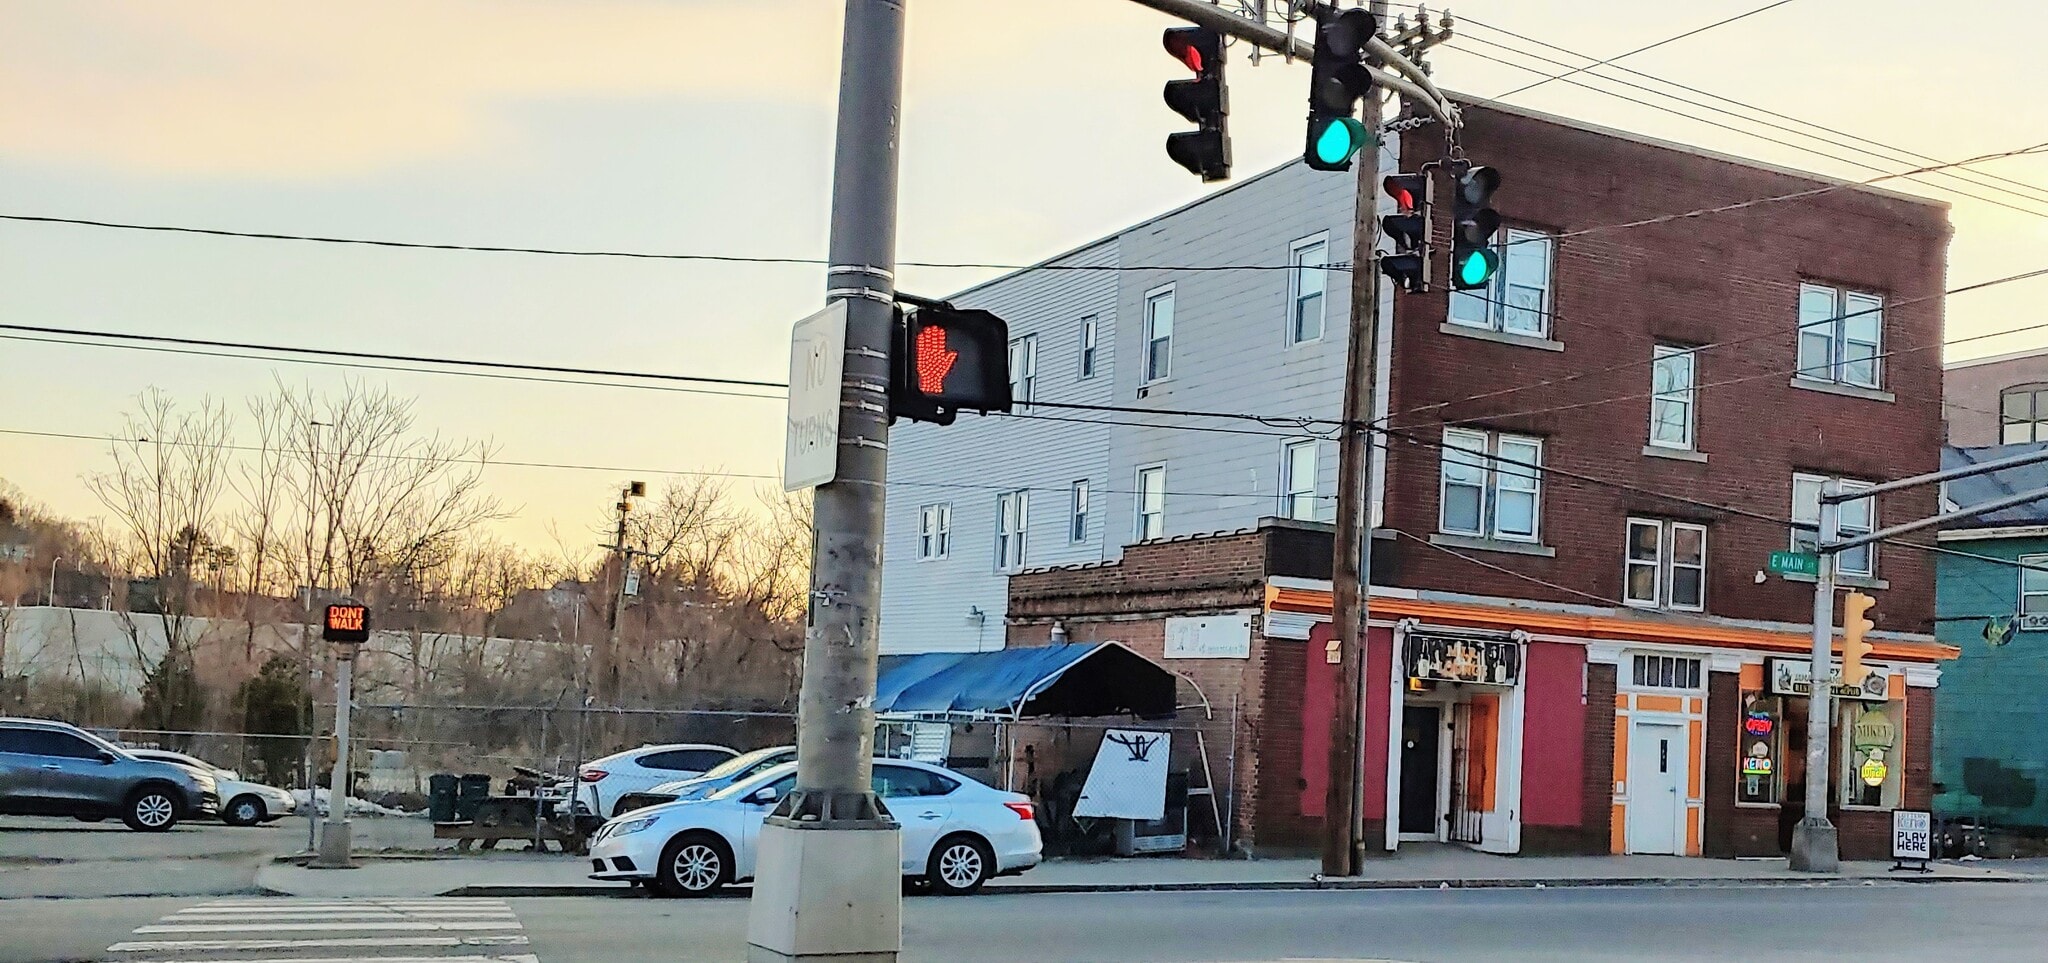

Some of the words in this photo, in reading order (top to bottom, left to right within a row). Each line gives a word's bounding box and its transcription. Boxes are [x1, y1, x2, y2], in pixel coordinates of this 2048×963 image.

[805, 340, 828, 392] NO
[789, 408, 835, 457] TURNS
[1772, 555, 1778, 568] E
[1781, 556, 1804, 570] MAIN
[330, 606, 365, 619] DONT
[330, 618, 364, 630] WALK
[1746, 718, 1773, 732] OPEN
[1898, 831, 1927, 842] PLAY
[1897, 841, 1927, 852] HERE
